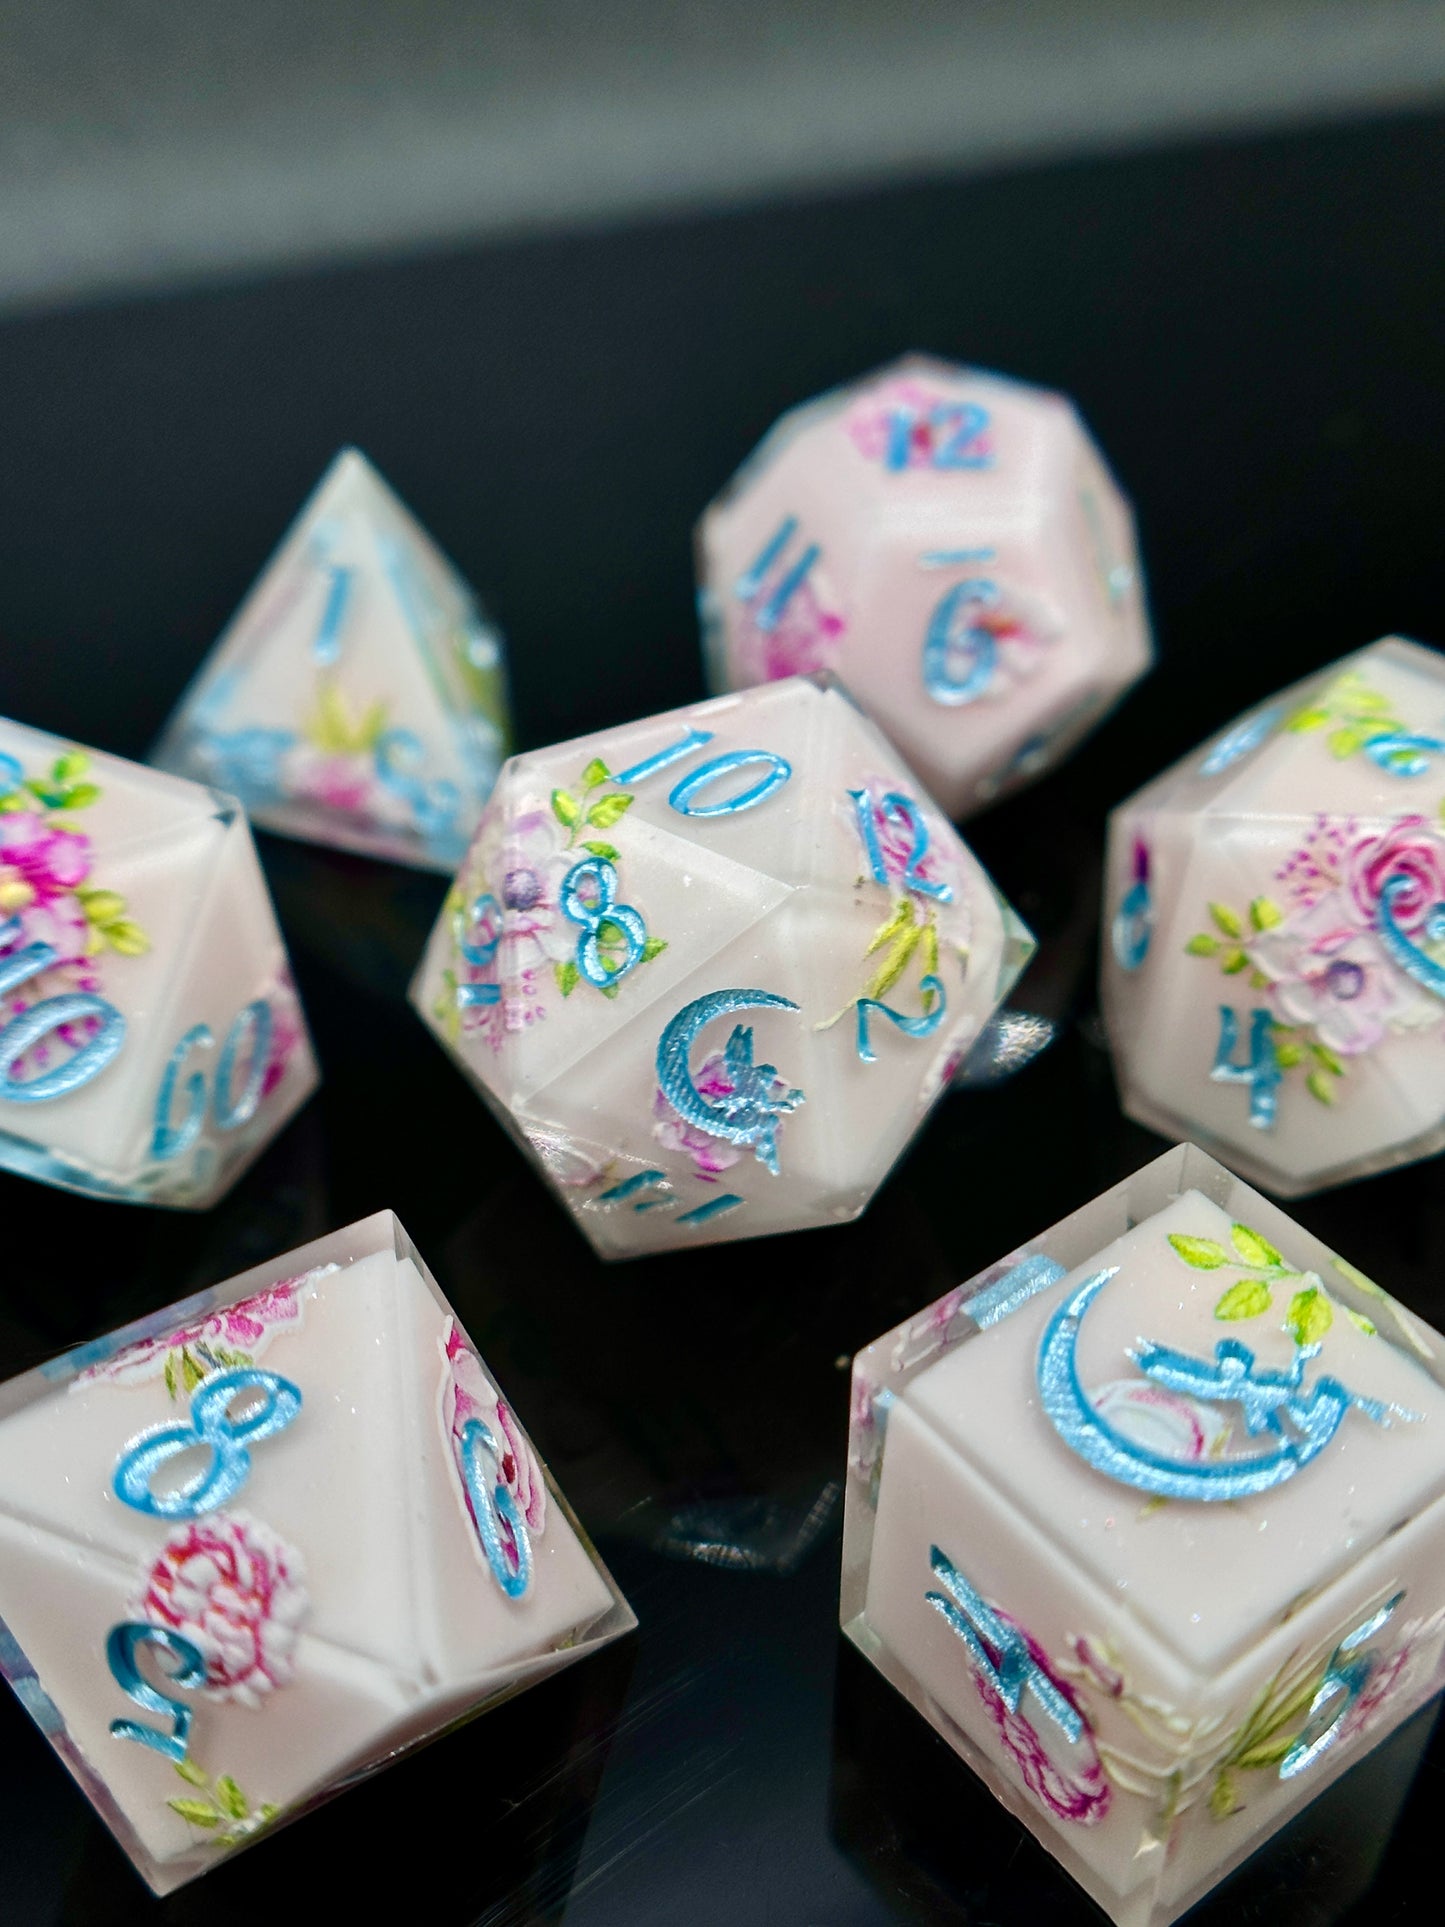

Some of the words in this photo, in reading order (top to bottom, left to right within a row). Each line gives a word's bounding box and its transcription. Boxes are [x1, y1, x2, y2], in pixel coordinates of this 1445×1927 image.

[886, 402, 997, 471] 12
[734, 516, 822, 632] 11
[610, 725, 792, 818] 10
[846, 788, 954, 903] 12
[560, 857, 647, 987] 8
[856, 975, 947, 1064] 2
[1211, 1005, 1280, 1129] 4
[112, 1368, 302, 1519] 8
[107, 1621, 206, 1764] 5
